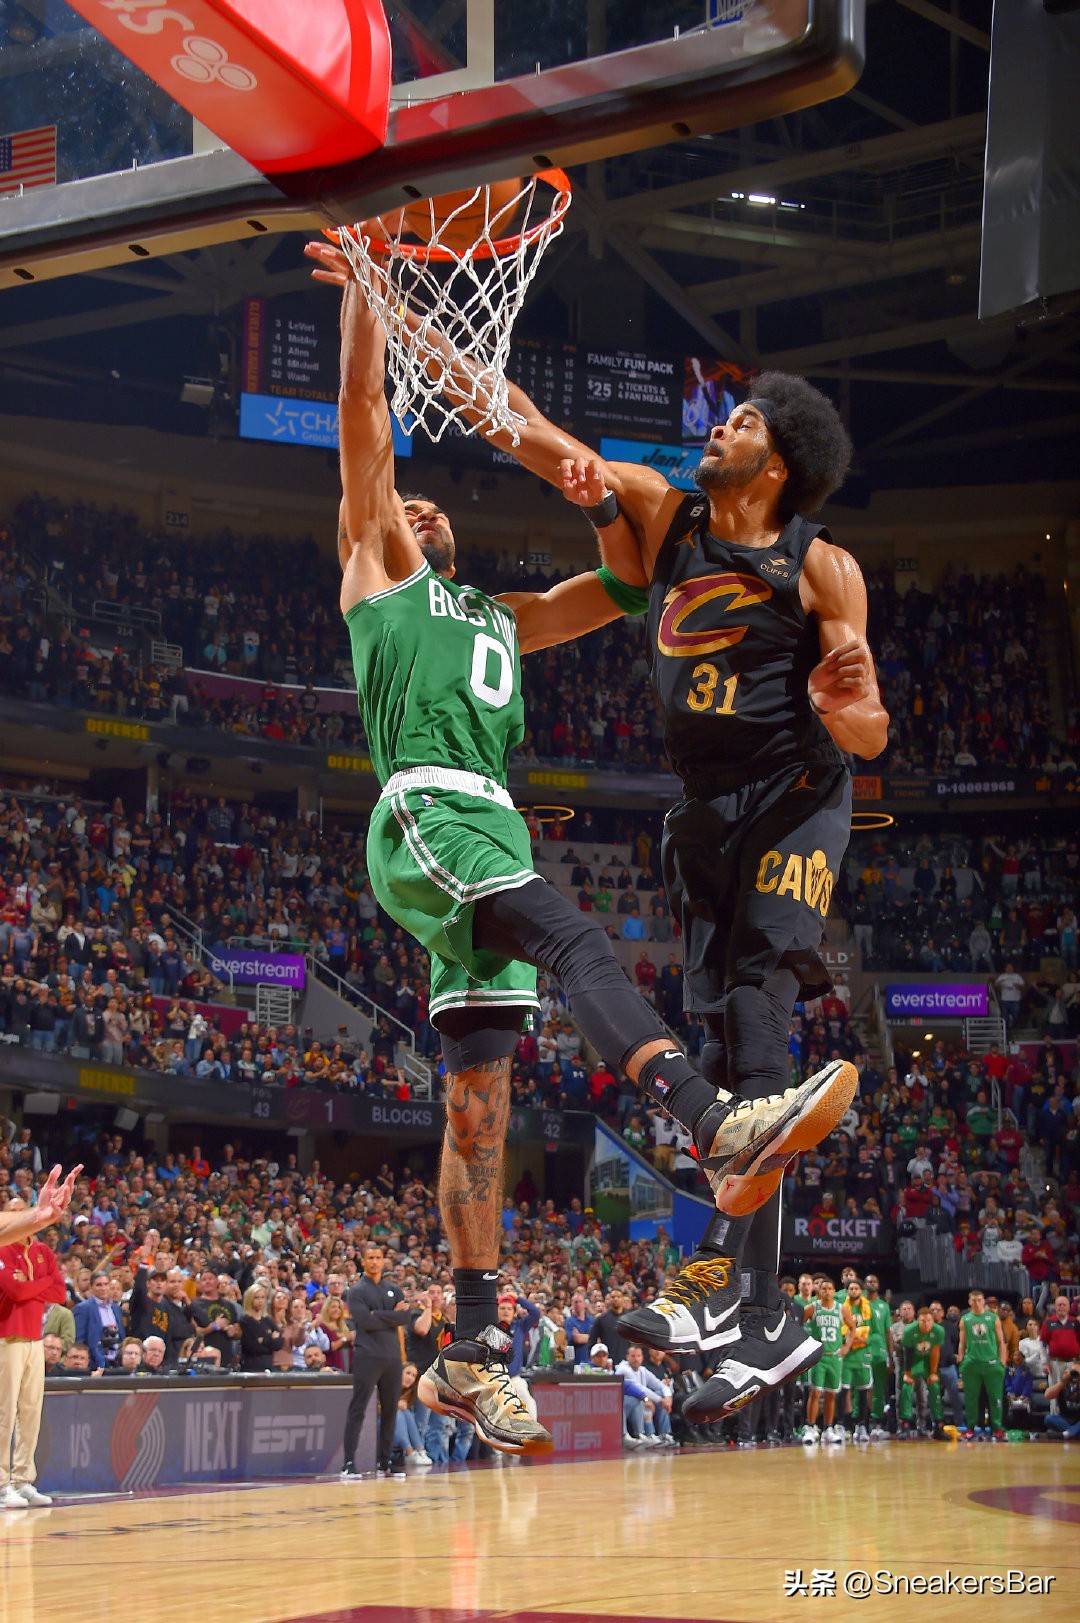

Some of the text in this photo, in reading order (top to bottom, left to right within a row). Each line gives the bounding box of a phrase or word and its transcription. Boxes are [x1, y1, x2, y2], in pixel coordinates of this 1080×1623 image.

[587, 353, 622, 368] FAMILY
[624, 358, 646, 371] FUN
[647, 361, 674, 374] PACK
[271, 385, 335, 400] TEAM TOTALS
[587, 379, 612, 397] $25
[625, 382, 659, 394] TICKETS
[625, 392, 642, 402] FAN
[642, 394, 669, 405] MEALS
[760, 563, 790, 579] CLIFFS
[470, 632, 514, 708] 0
[687, 662, 742, 715] 31
[86, 718, 149, 741] DEFENSE
[528, 771, 587, 789] DEFENSE
[755, 850, 833, 917] CAVS
[212, 959, 299, 978] everstream
[891, 992, 982, 1007] everstream
[254, 1099, 432, 1125] 43 1 BLOCKS
[544, 1123, 560, 1138] 42
[794, 1218, 880, 1238] ROCKET
[812, 1238, 864, 1252] Mortgage
[816, 1315, 840, 1328] BOSTON
[821, 1327, 837, 1342] 13
[70, 1401, 326, 1473] VS NEXT ESPN
